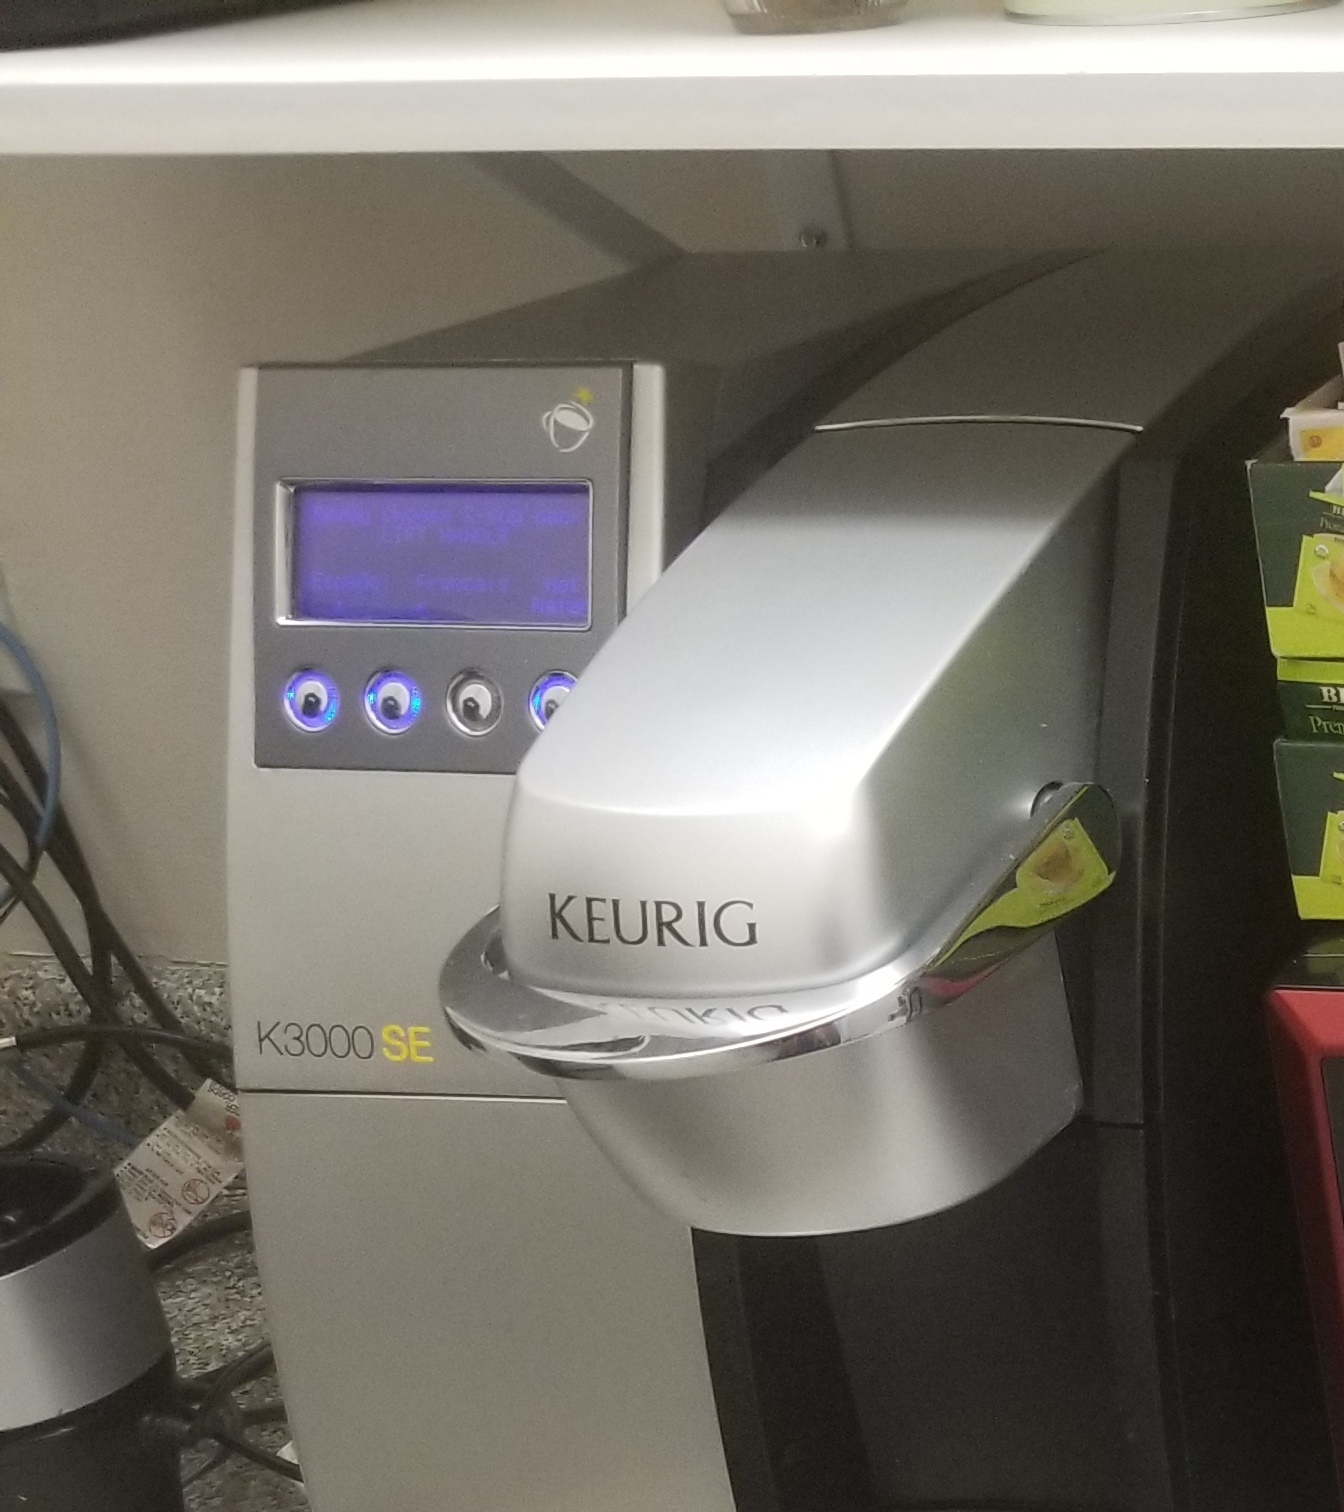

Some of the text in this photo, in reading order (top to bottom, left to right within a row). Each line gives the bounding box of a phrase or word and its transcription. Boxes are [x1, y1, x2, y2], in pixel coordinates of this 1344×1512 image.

[549, 893, 758, 947] KEURIG
[257, 1021, 434, 1062] K3000 SE
